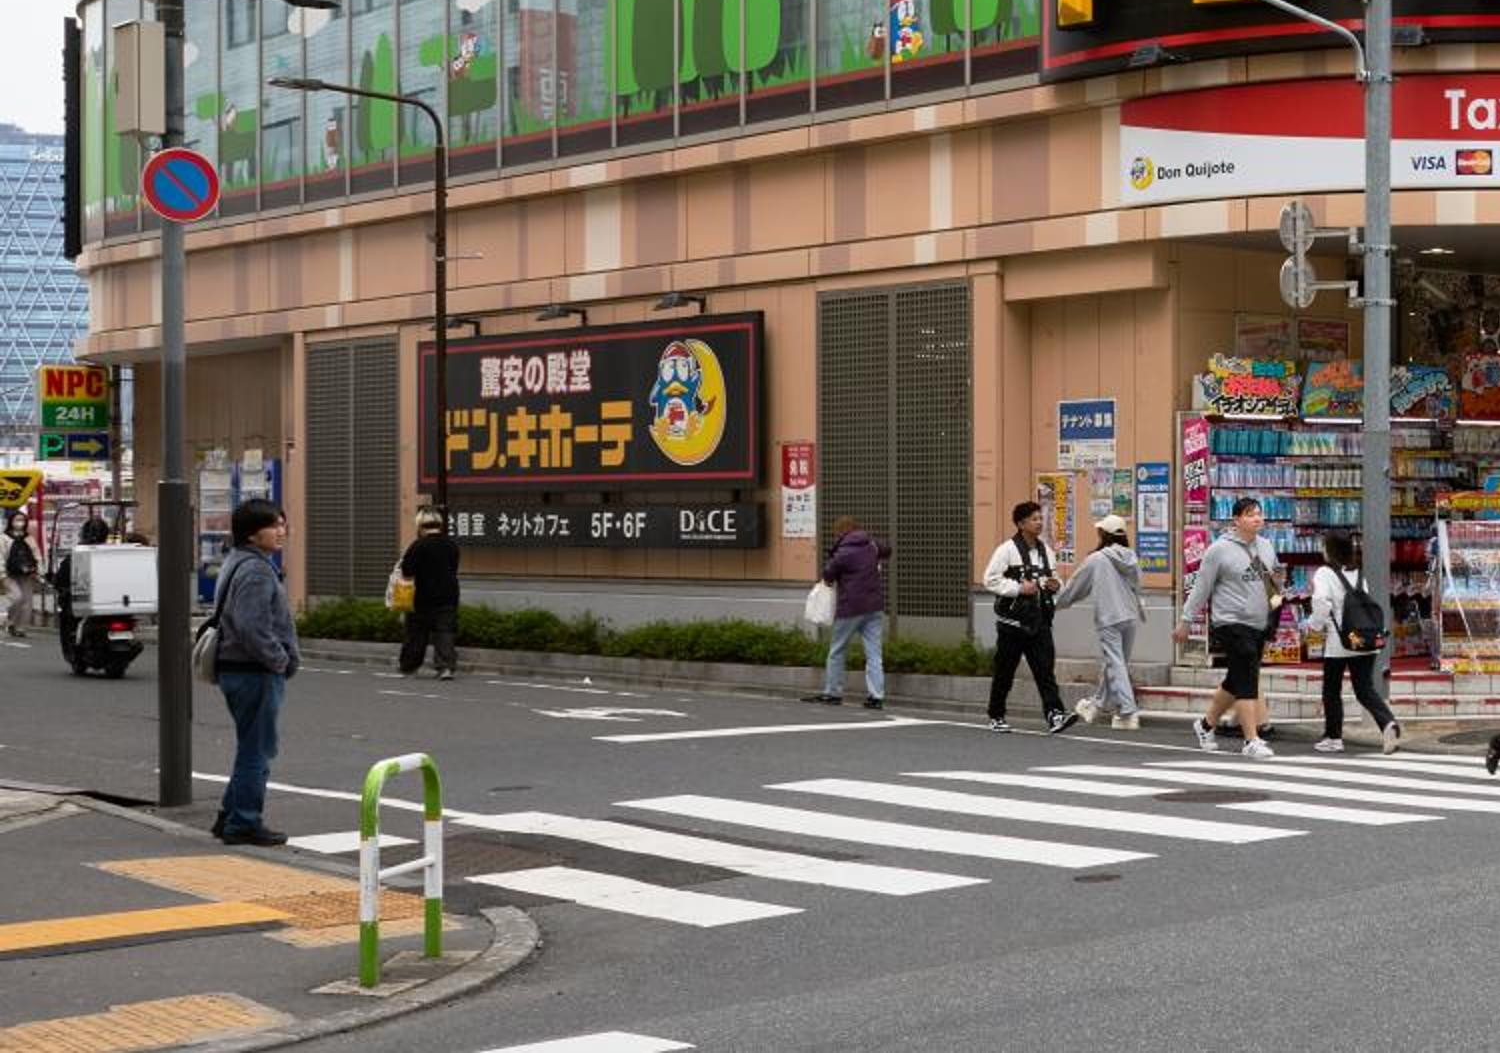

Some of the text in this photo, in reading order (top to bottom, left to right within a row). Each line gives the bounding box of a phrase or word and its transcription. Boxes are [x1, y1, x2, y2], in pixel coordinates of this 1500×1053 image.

[1157, 160, 1235, 180] Don Quijote
[1411, 155, 1447, 170] VISA
[45, 369, 104, 397] NPC
[481, 350, 592, 398] 驚安の殿堂
[55, 406, 95, 421] 24H
[497, 512, 571, 537] ネットカフェ
